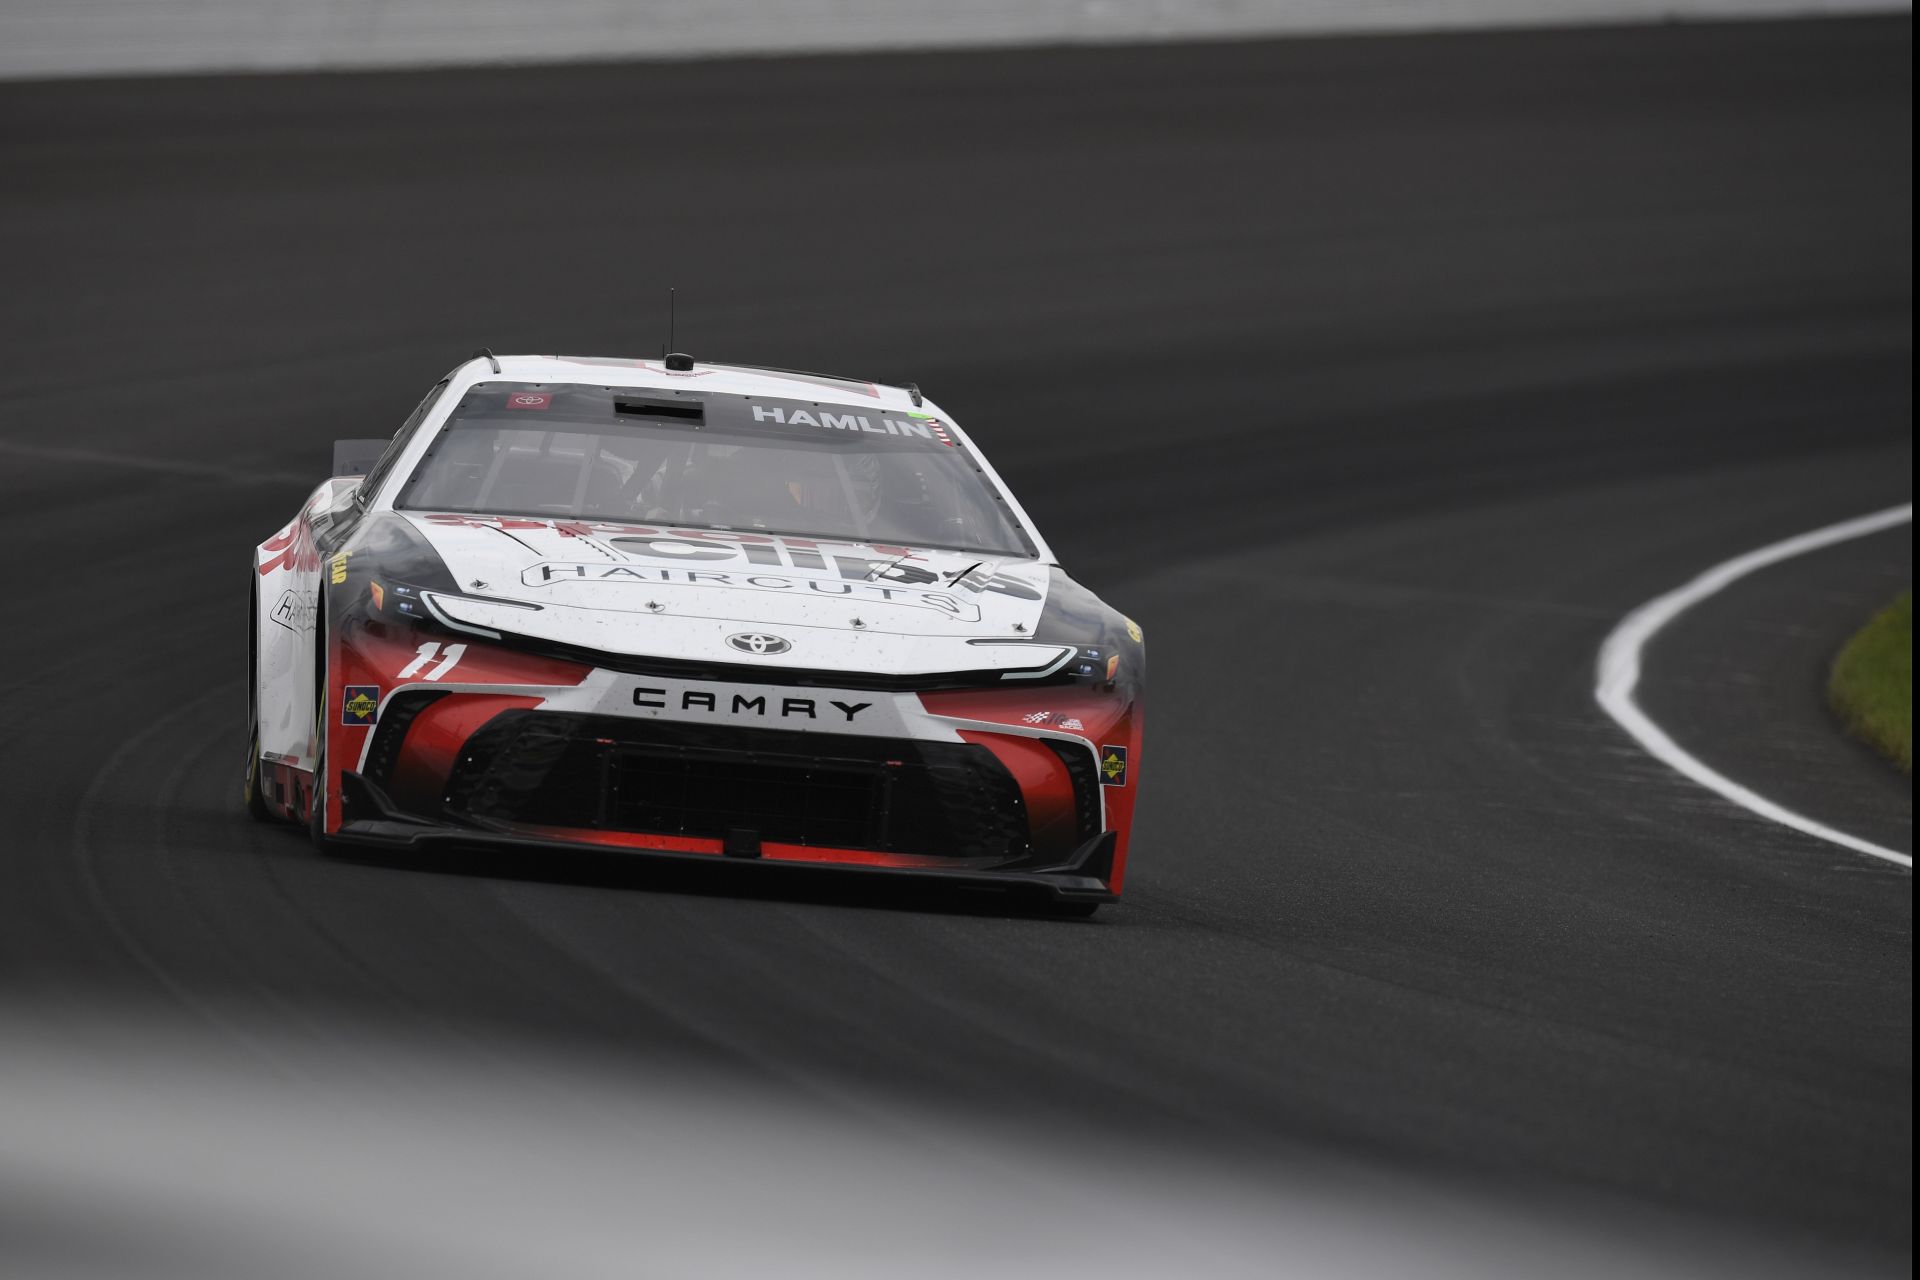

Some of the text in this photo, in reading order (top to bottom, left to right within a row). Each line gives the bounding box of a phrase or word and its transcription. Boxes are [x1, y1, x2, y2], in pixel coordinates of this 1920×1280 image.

[752, 405, 932, 439] HAMLIN
[541, 565, 960, 613] HAIRCUTS
[397, 642, 467, 681] 11
[347, 701, 376, 711] SUNOCO
[633, 687, 872, 721] CAMRY
